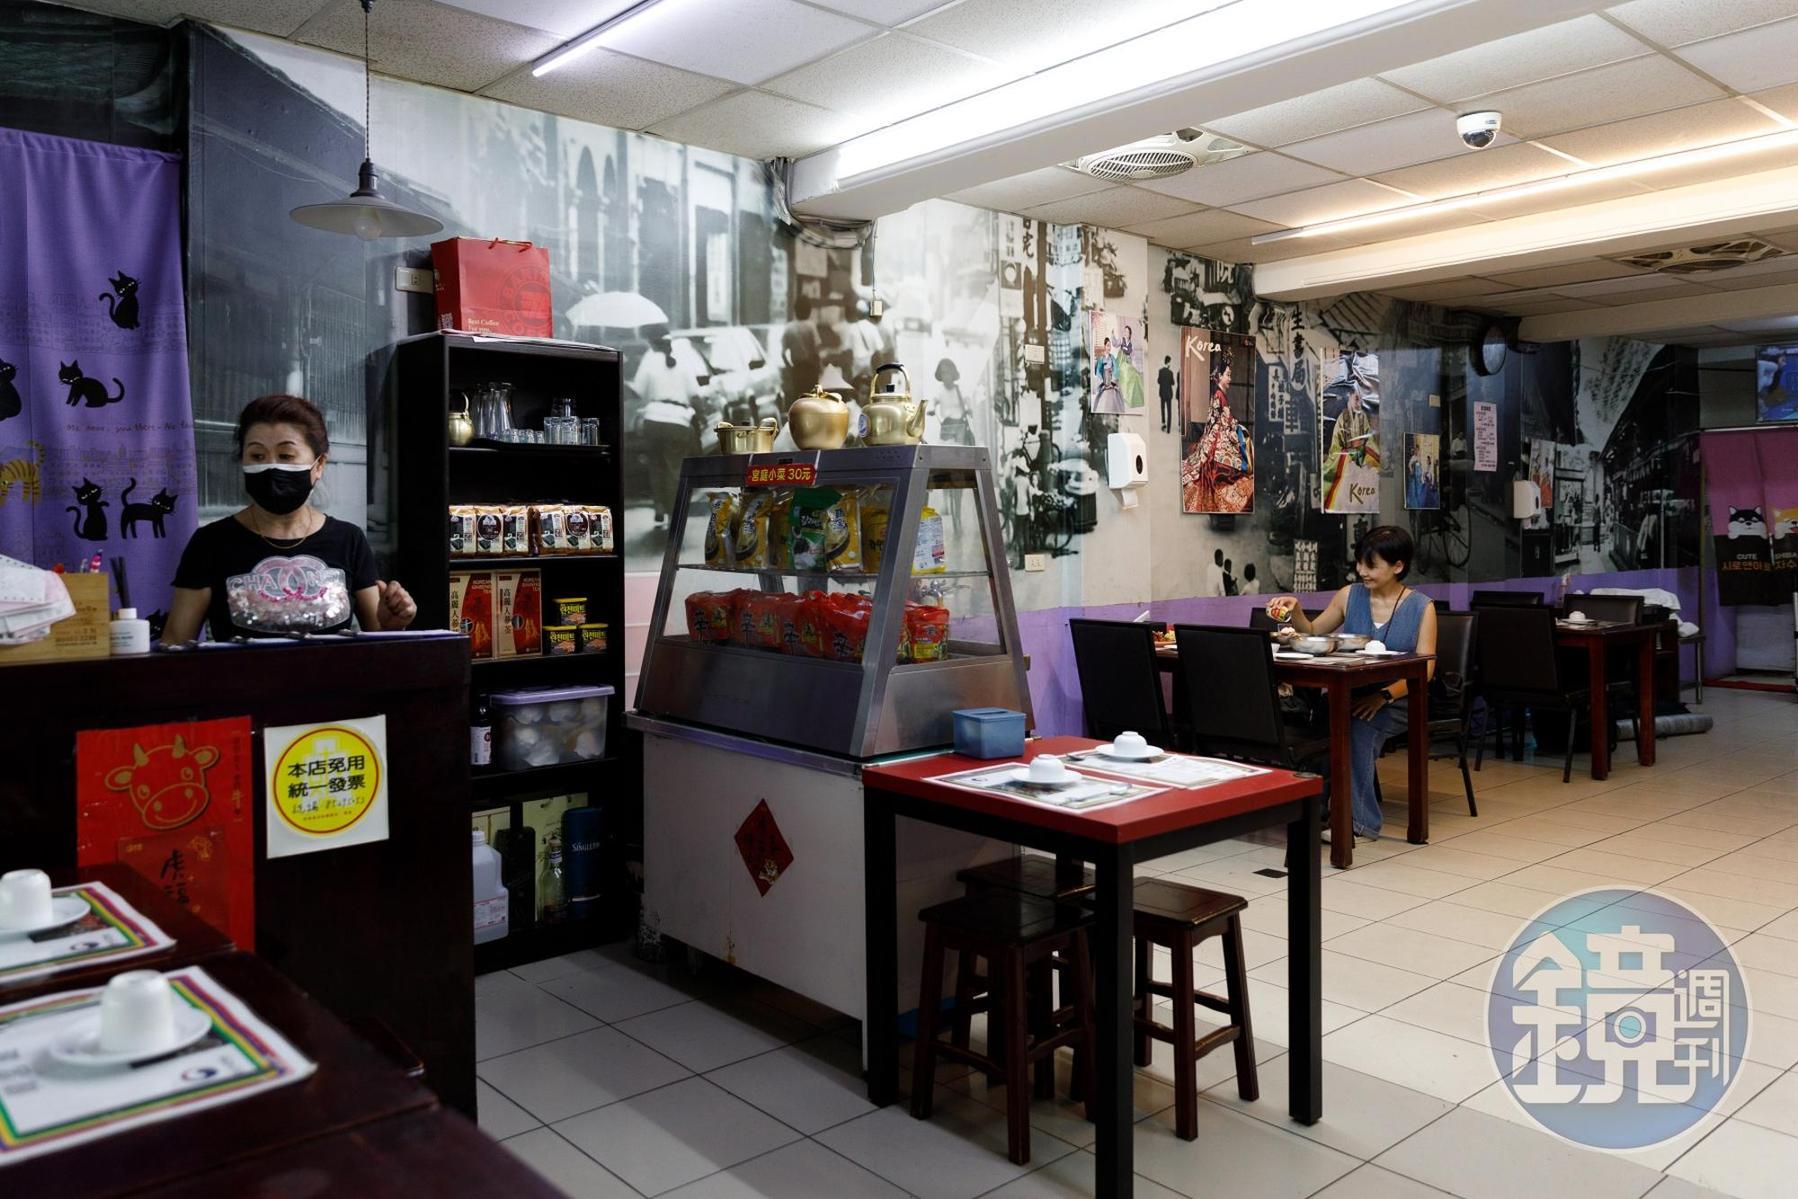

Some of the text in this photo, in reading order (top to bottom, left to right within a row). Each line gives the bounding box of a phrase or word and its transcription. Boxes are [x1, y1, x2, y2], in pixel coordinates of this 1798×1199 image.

[1185, 335, 1222, 361] Korea
[787, 467, 811, 480] 30元
[1350, 483, 1376, 505] Korea
[287, 754, 365, 779] 本店免用
[287, 774, 366, 799] 統一發票
